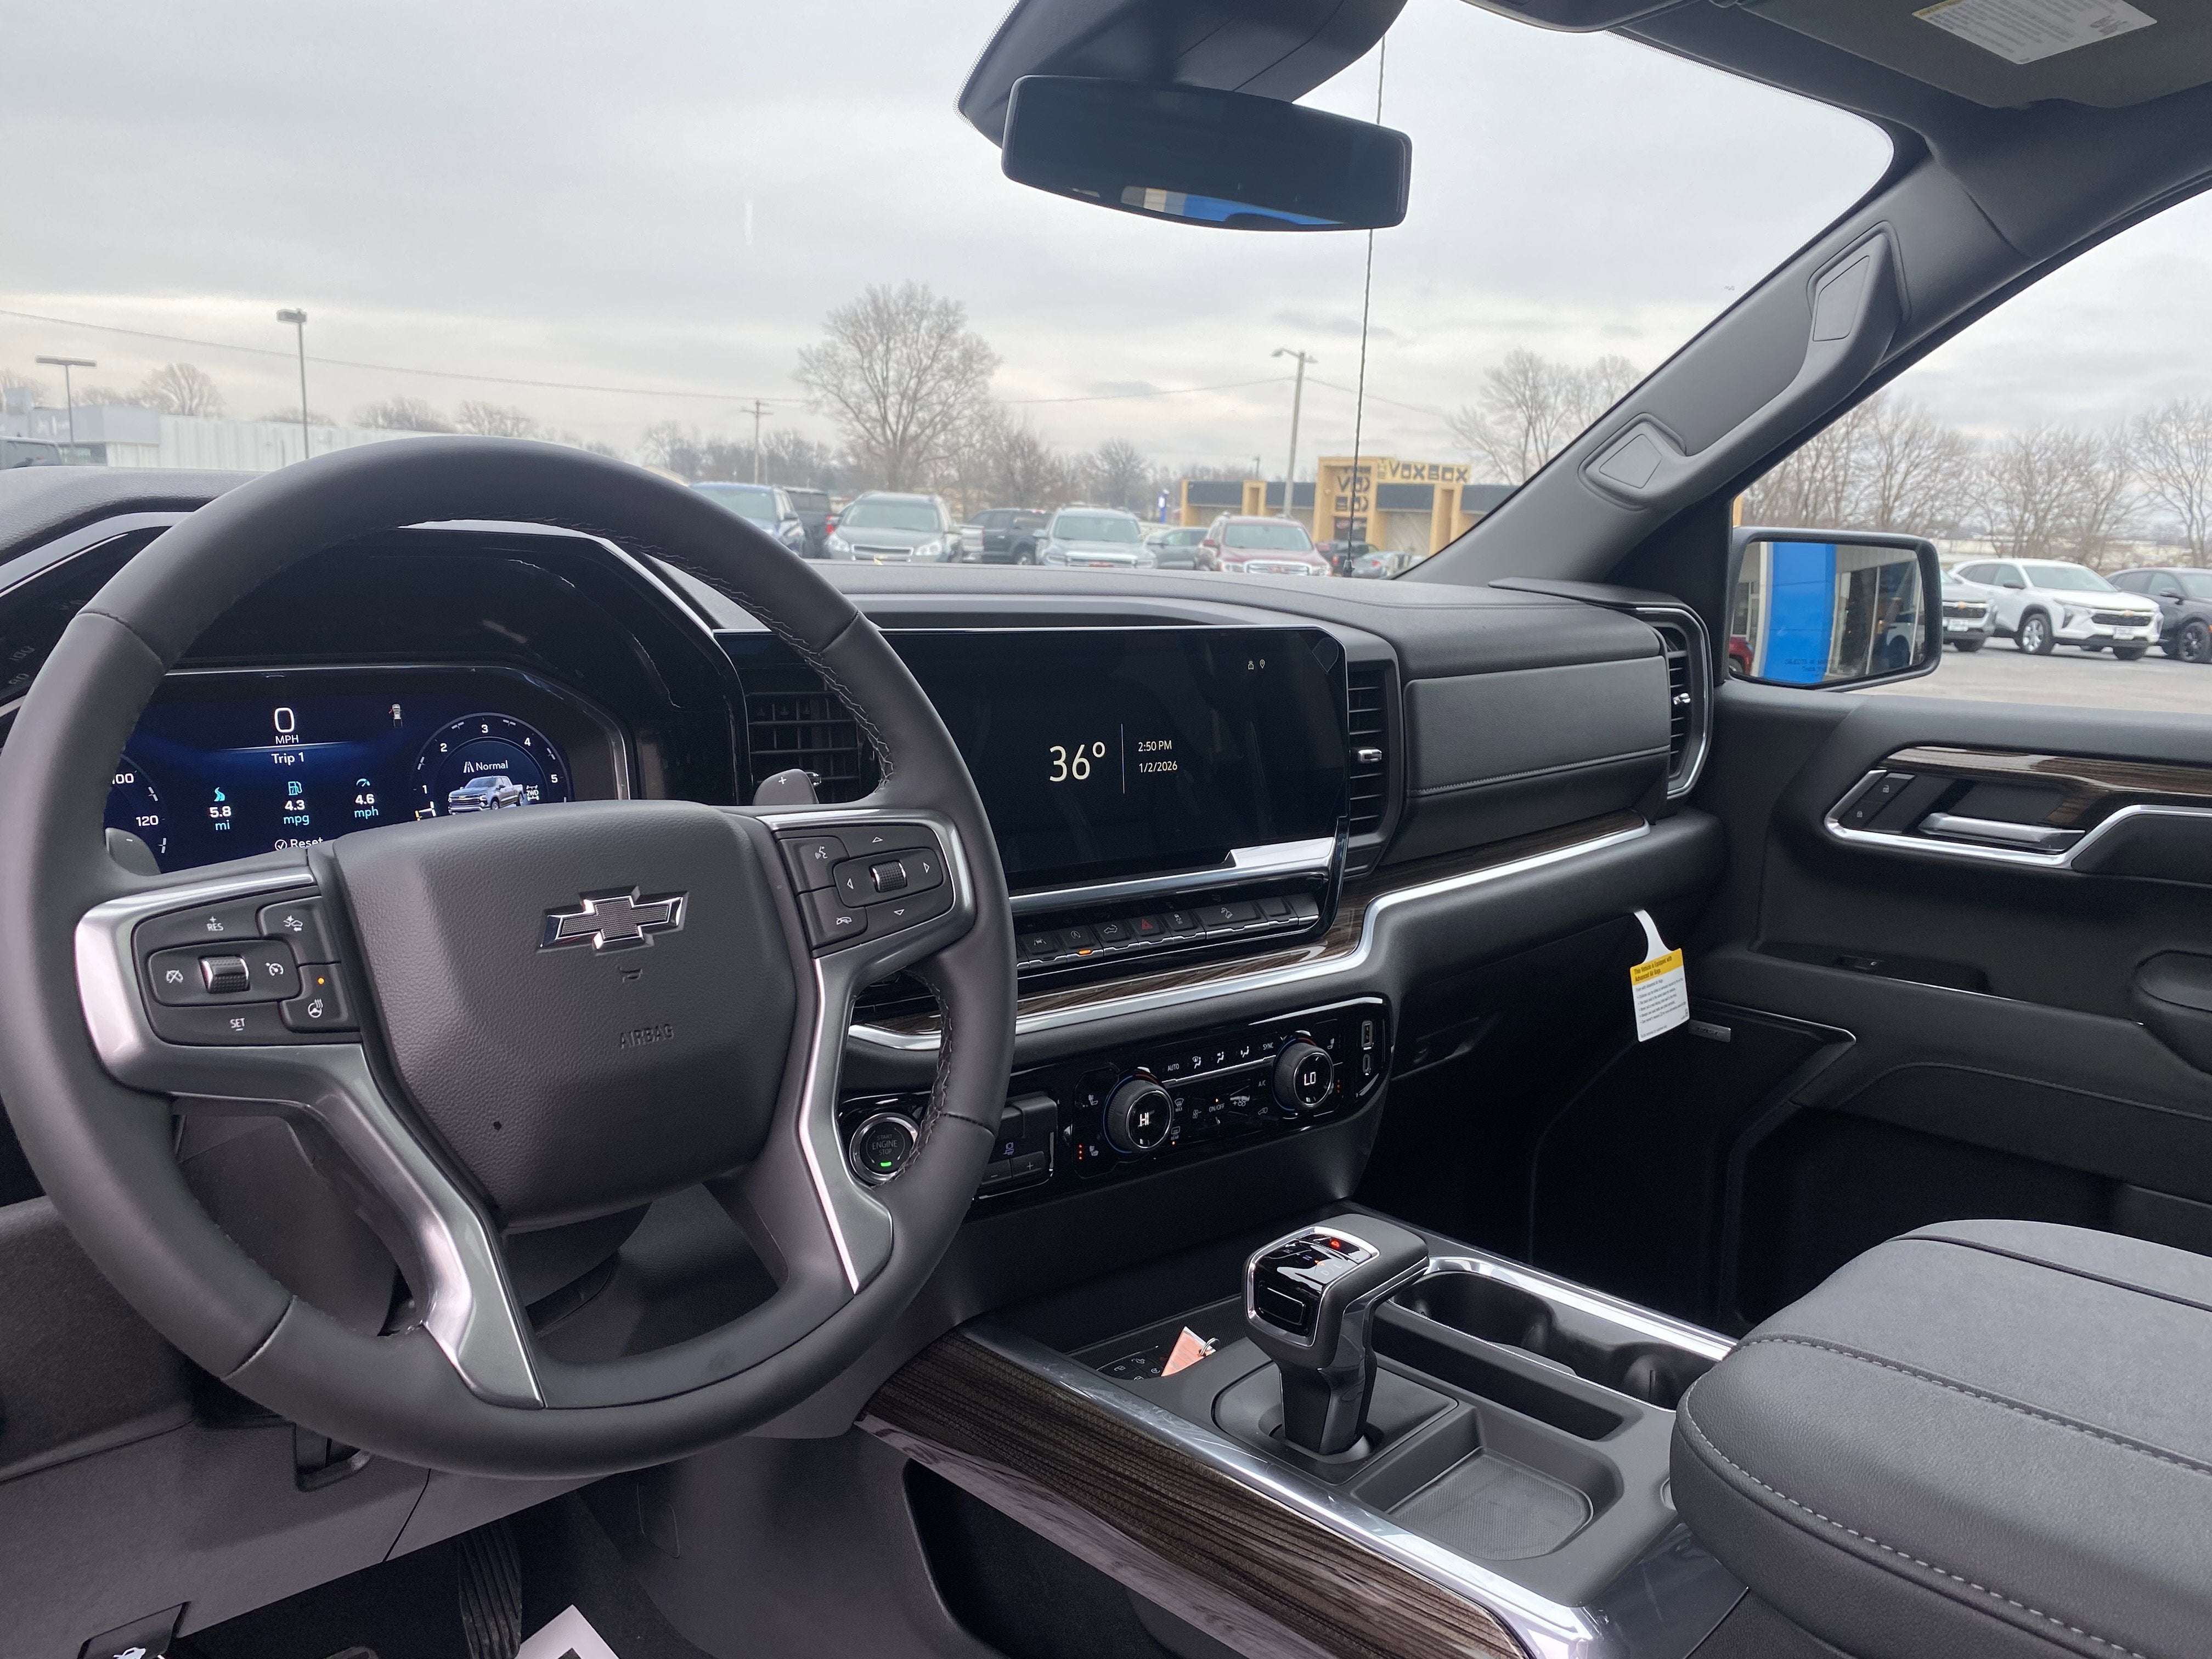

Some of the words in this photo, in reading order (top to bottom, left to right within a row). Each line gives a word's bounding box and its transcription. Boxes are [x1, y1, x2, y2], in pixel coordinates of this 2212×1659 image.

[274, 707, 295, 733] 0
[481, 724, 489, 733] 3
[275, 734, 300, 744] MPH
[524, 737, 531, 746] 4
[440, 743, 448, 752] 2
[1138, 741, 1156, 752] 2:50
[1158, 740, 1172, 751] PM
[271, 752, 295, 766] Trip
[298, 752, 304, 762] 1
[475, 760, 509, 771] Normal
[1139, 760, 1178, 773] 1/2/2026
[550, 774, 558, 783] 5
[421, 785, 428, 794] 1
[355, 793, 375, 805] 4.6
[284, 799, 306, 811] 4.3
[209, 805, 232, 818] 5.8
[354, 806, 379, 820] mph
[136, 815, 159, 827] 120
[215, 819, 231, 831] mi
[283, 815, 310, 826] mpg
[290, 837, 324, 848] Reset
[206, 923, 224, 932] RES
[229, 1018, 246, 1029] SET
[620, 1023, 675, 1049] AIRBAG
[1262, 1041, 1274, 1051] SYNC
[1167, 1063, 1180, 1072] AUTO
[1304, 1071, 1316, 1086] LO
[1209, 1103, 1226, 1113] ON/OFF
[1139, 1112, 1149, 1126] HI
[872, 1139, 898, 1150] ENGINE
